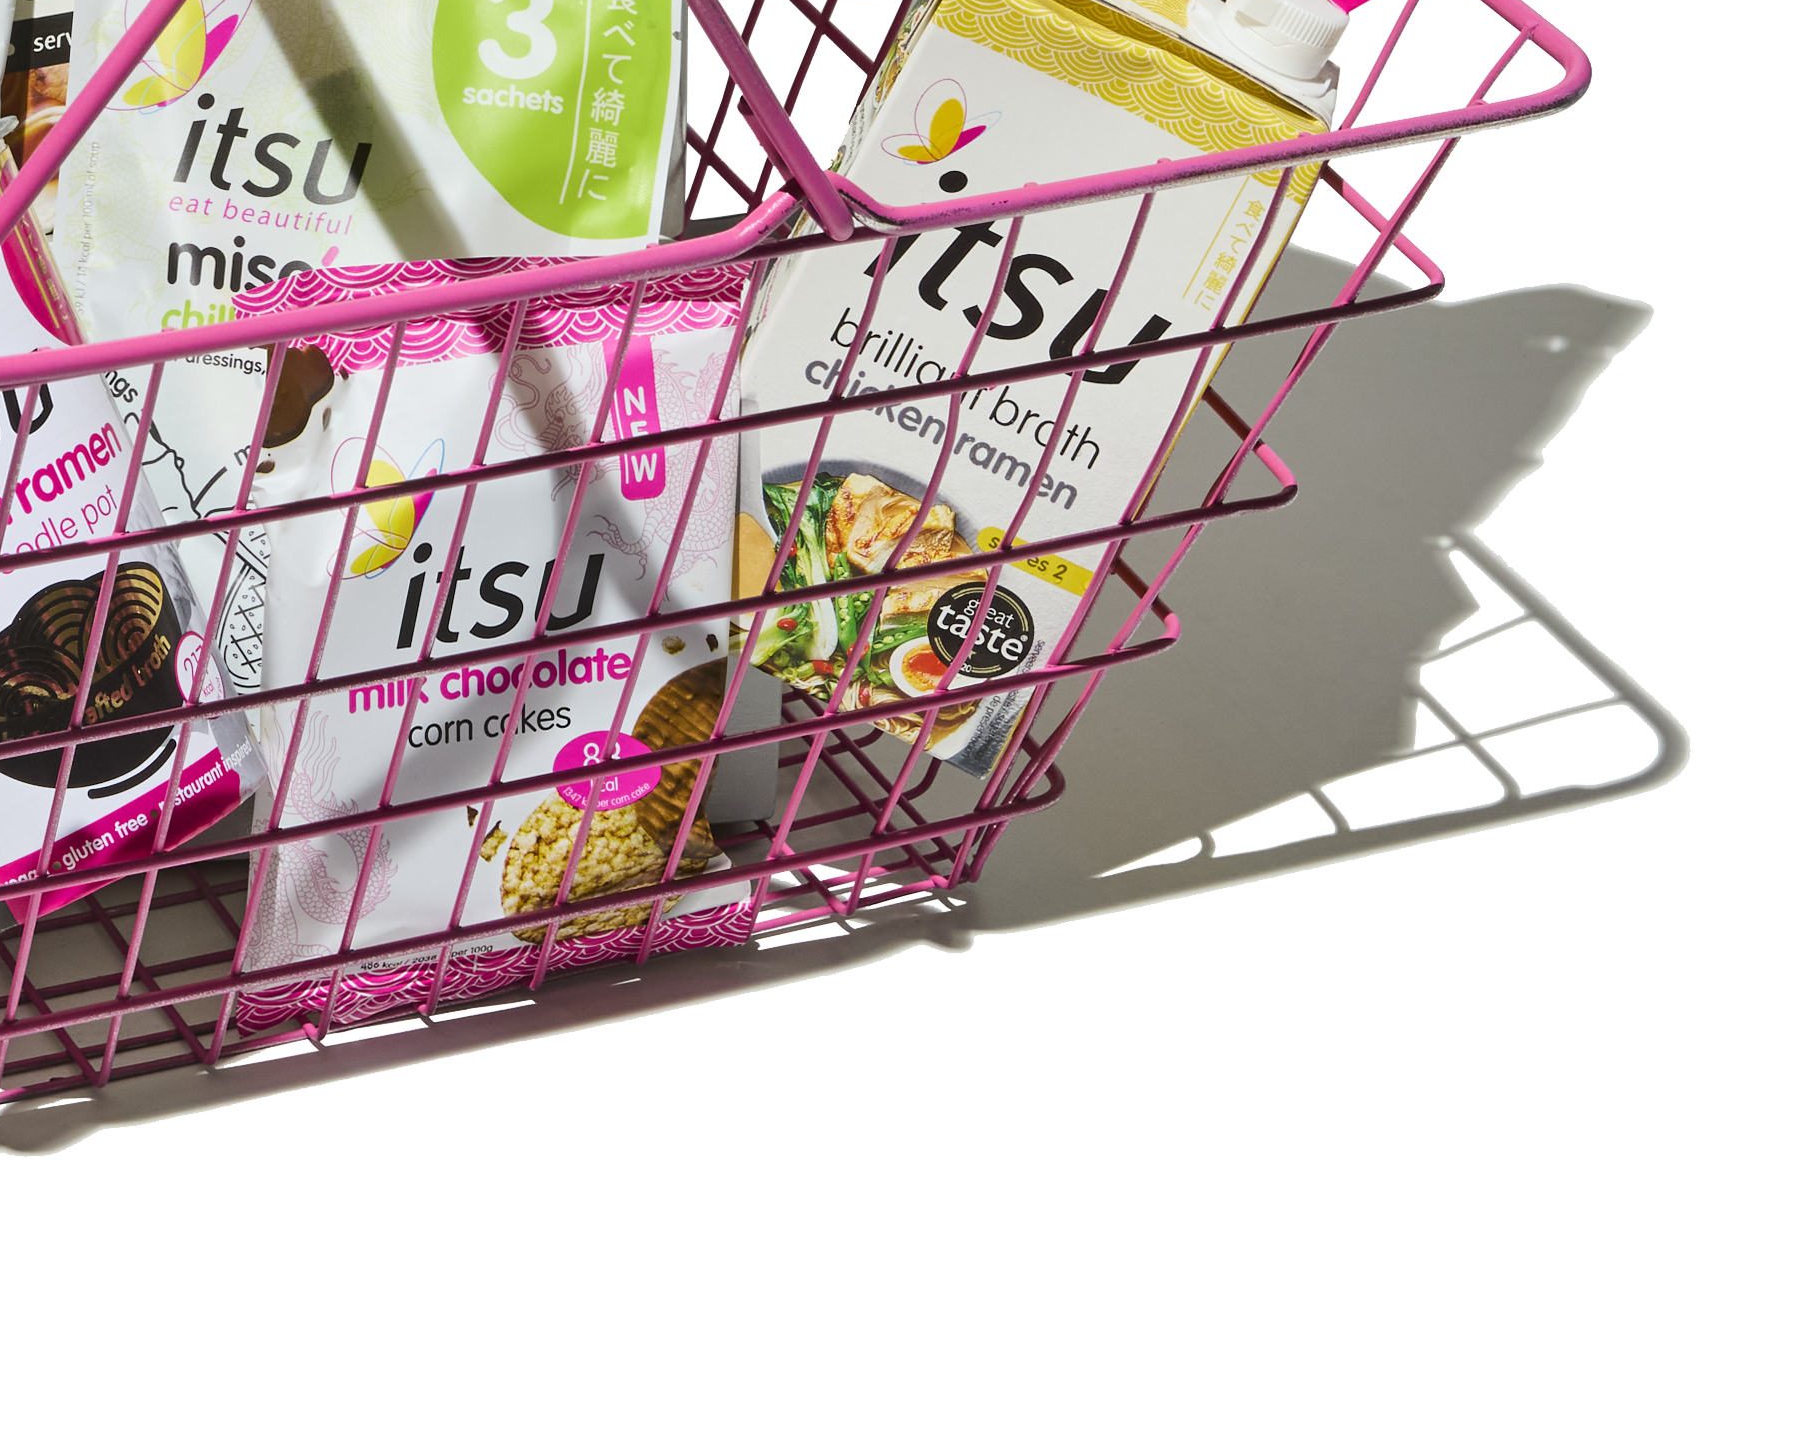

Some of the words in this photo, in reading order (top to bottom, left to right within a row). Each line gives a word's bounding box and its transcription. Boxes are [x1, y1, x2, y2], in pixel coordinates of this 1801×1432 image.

[463, 84, 564, 115] sachets
[173, 94, 373, 205] itsu
[169, 195, 213, 219] eat
[223, 193, 352, 236] beautiful
[1194, 200, 1266, 311] 食べて綺麗に
[830, 307, 989, 410] brillia
[805, 359, 946, 445] chiken
[954, 432, 1078, 510] ramen
[15, 422, 122, 515] ramen
[80, 484, 118, 535] pot
[396, 542, 605, 650] itsu
[1053, 564, 1068, 582] 2
[937, 604, 1024, 661] taste
[964, 599, 1015, 629] geat
[349, 674, 429, 714] milk
[440, 649, 633, 700] chocolate
[408, 718, 474, 748] corn
[62, 831, 114, 871] gluten
[113, 812, 149, 840] free
[223, 736, 253, 773] inspired
[610, 790, 631, 807] corn
[631, 781, 651, 799] cake
[451, 948, 468, 957] per
[470, 944, 493, 954] 100g
